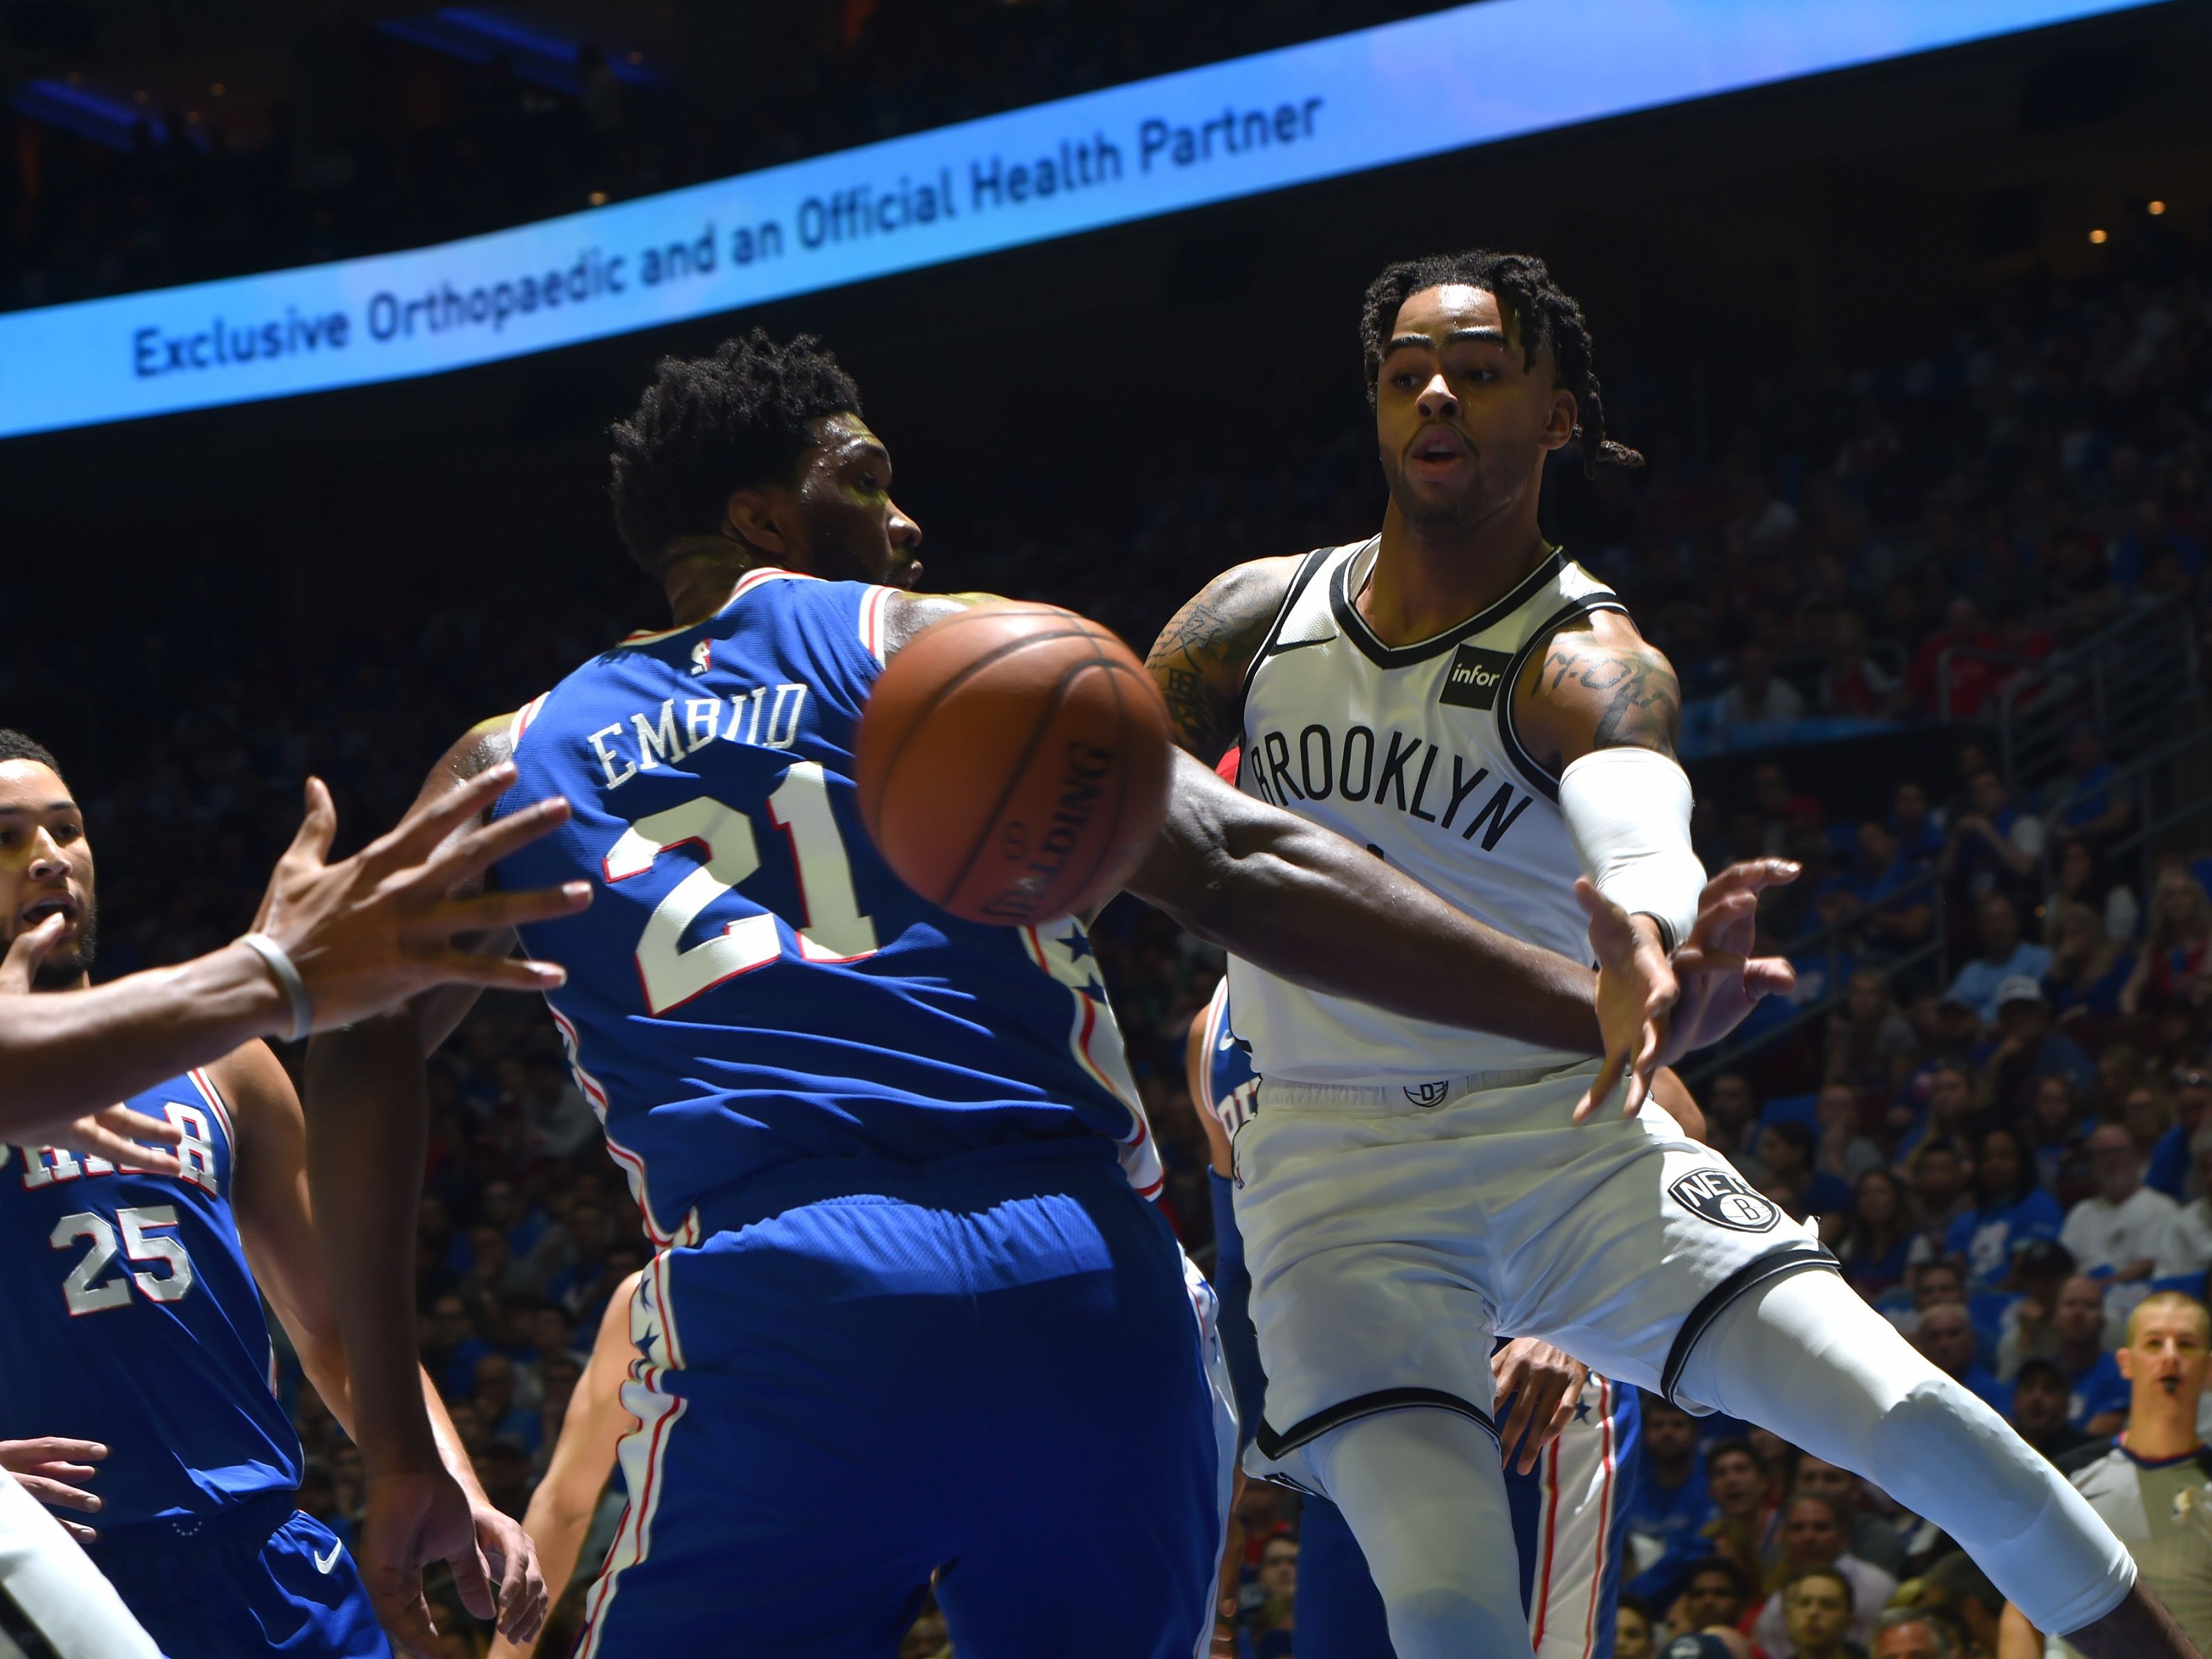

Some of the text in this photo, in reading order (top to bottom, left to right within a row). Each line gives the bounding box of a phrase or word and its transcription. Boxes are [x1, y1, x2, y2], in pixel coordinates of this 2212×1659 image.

[132, 95, 1324, 379] Exclusive Orthopaedic and an Official Health Partner
[1451, 662, 1501, 688] infor
[587, 683, 808, 790] EMBIID
[1251, 724, 1534, 852] BROOKLYN
[601, 760, 881, 1018] 21
[50, 1205, 194, 1317] 25
[1732, 1198, 1761, 1221] B
